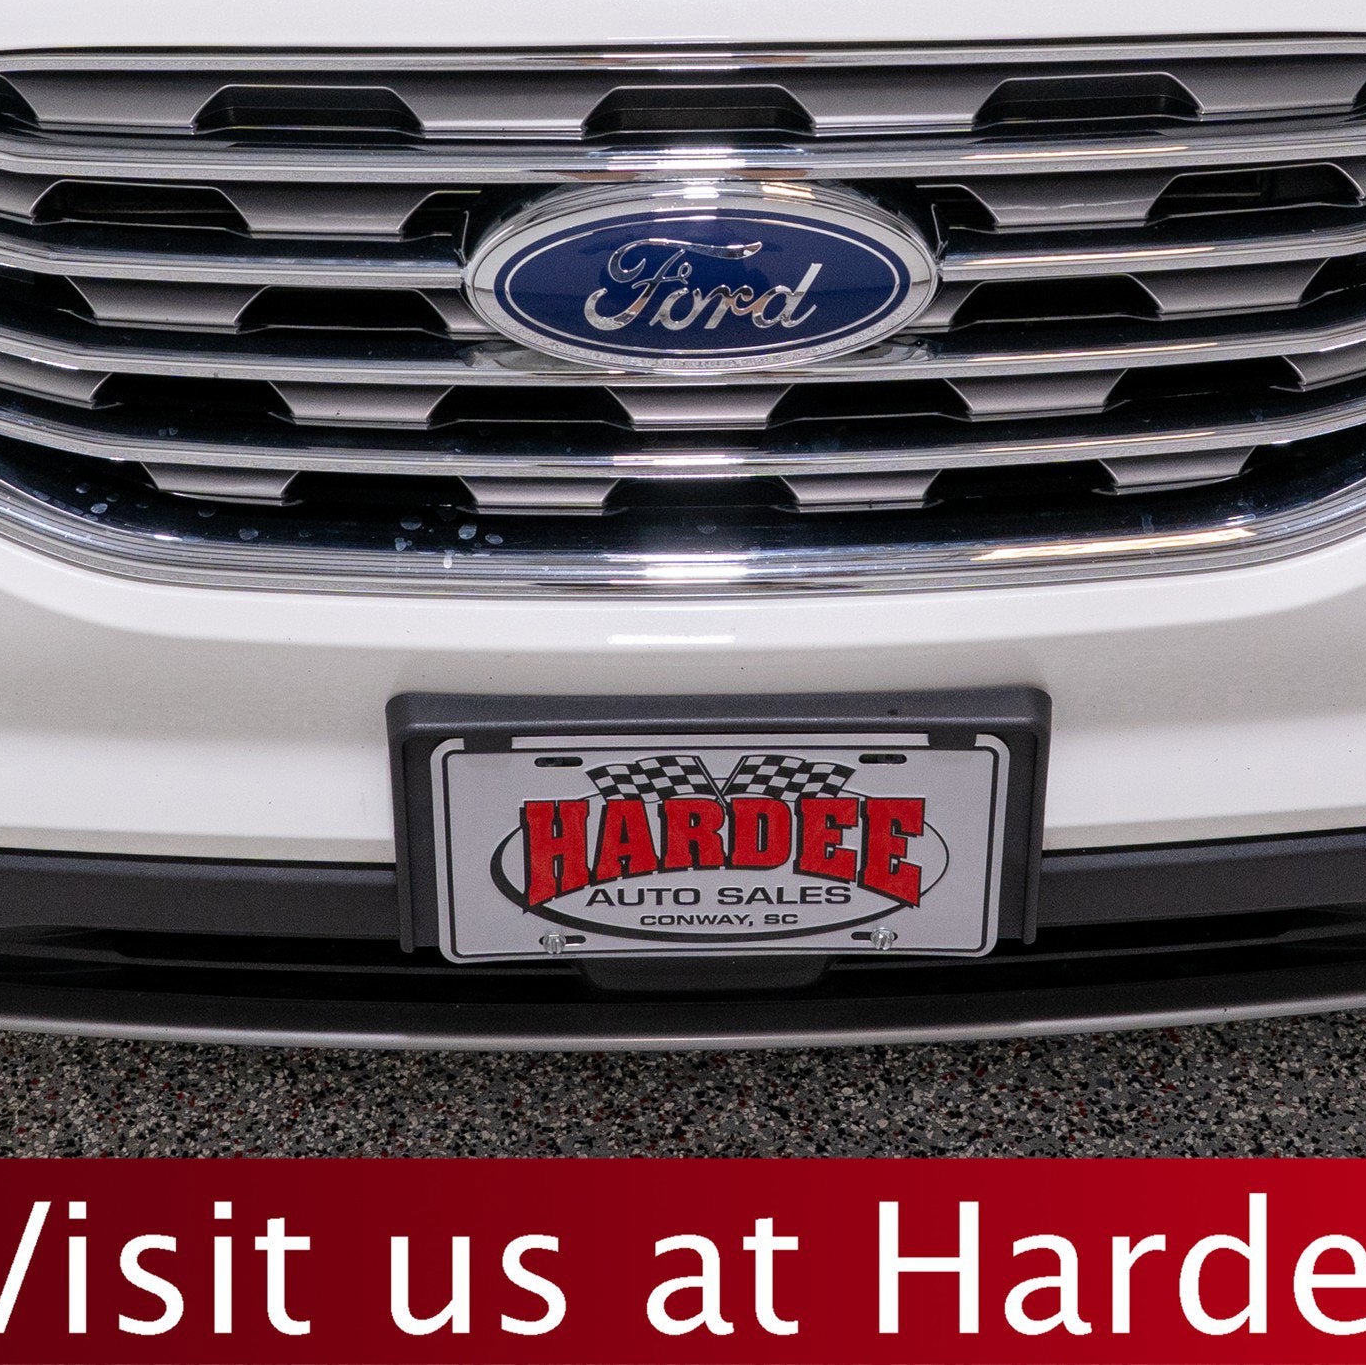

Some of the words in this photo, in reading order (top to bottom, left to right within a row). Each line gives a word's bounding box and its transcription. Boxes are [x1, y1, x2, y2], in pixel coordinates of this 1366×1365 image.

[583, 238, 823, 331] Ford
[520, 796, 926, 913] HARDEE
[585, 887, 701, 907] AUTO
[716, 885, 853, 905] SALES
[639, 914, 754, 927] CONWAY,
[763, 913, 799, 925] SC
